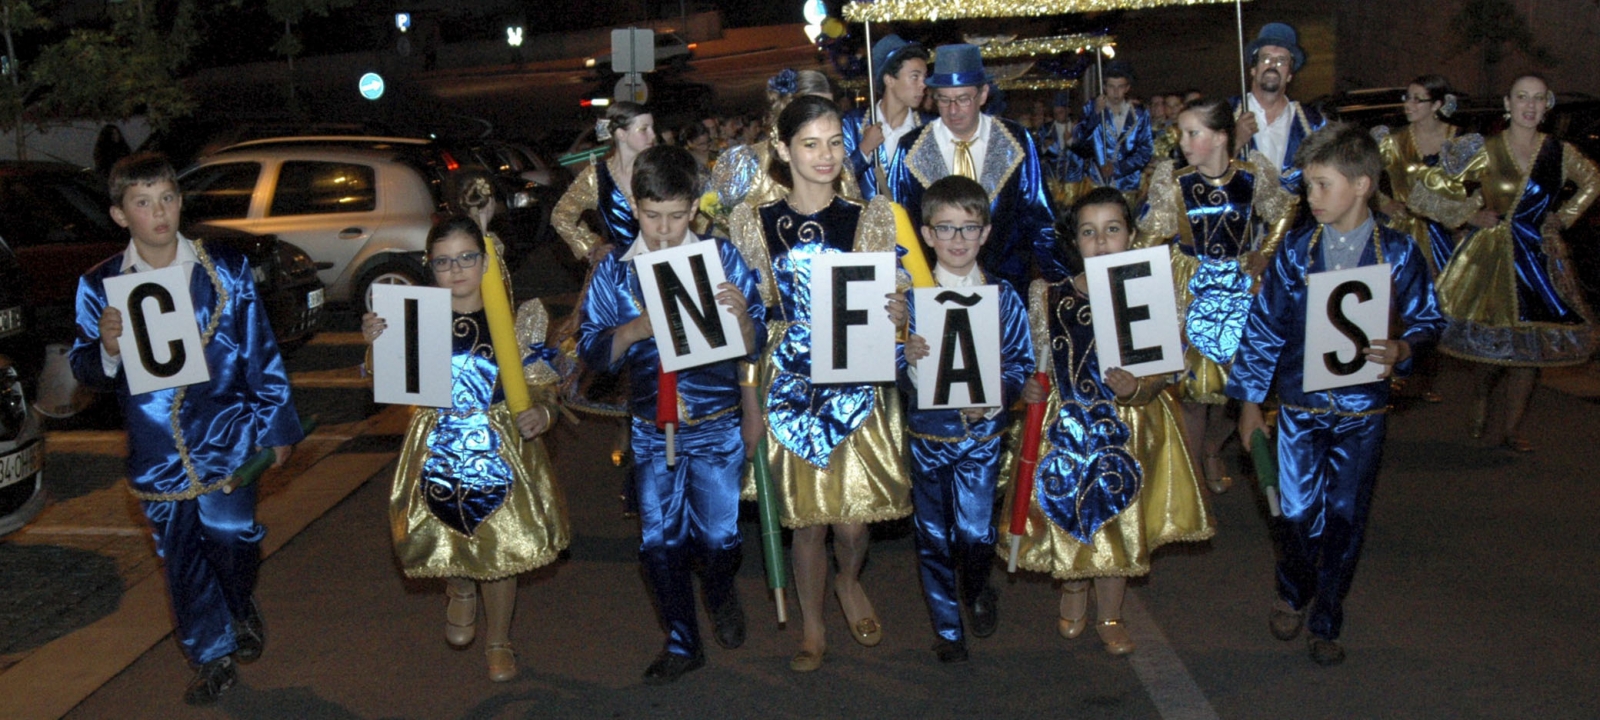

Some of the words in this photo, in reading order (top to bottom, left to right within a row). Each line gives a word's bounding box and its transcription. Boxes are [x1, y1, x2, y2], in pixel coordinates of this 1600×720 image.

[397, 13, 408, 27] P
[127, 282, 187, 378] C
[653, 253, 728, 357] N
[832, 265, 876, 370] F
[1107, 261, 1164, 367] E
[1323, 280, 1373, 377] S
